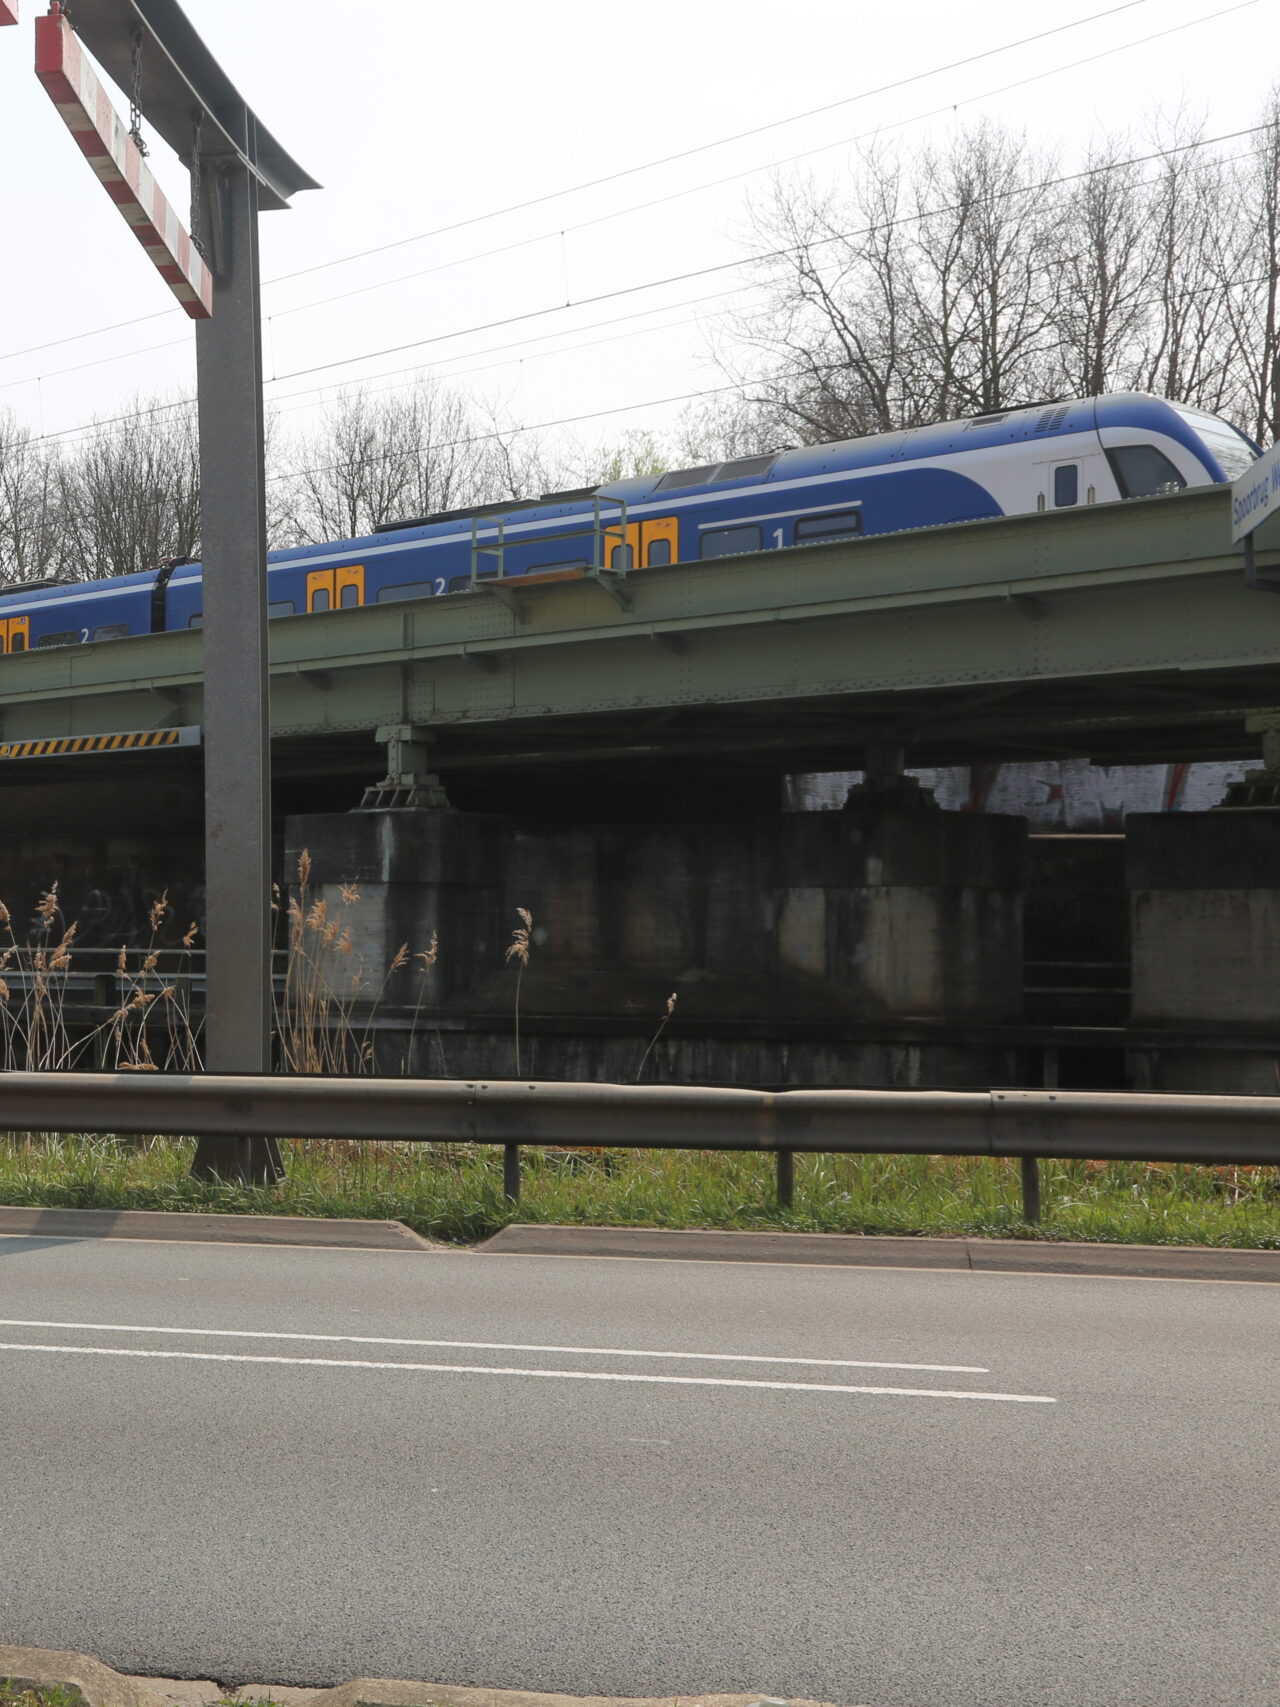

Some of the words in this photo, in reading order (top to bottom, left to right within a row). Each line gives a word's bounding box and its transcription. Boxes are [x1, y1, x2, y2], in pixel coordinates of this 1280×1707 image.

[1234, 476, 1269, 527] Spoorbrug
[1272, 459, 1280, 493] W
[773, 528, 784, 548] 1
[435, 577, 446, 596] 2
[81, 628, 89, 643] 2
